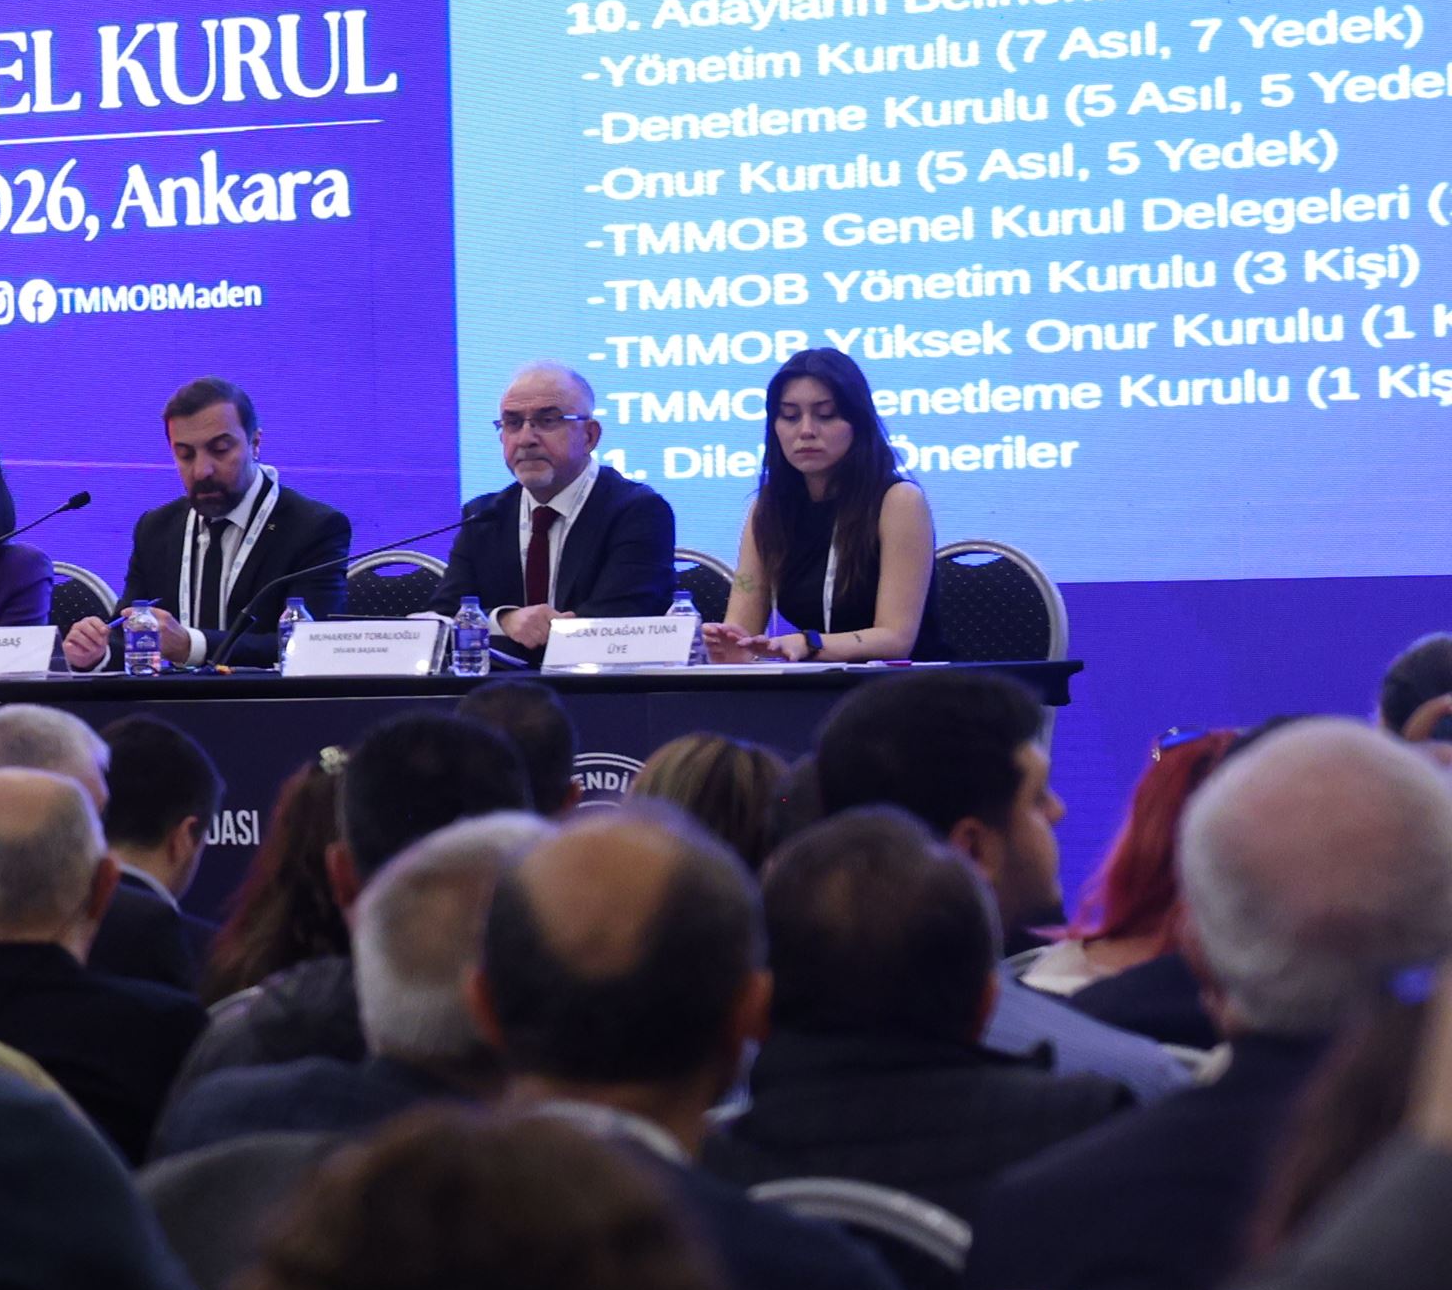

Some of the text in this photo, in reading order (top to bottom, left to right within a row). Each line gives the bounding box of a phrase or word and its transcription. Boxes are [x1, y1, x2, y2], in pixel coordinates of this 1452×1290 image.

[568, 1, 640, 34] 10.
[584, 6, 1422, 86] -Yönetim Kurulu (7 Asıl, 7 Yedek)
[99, 10, 397, 108] KURUL
[585, 105, 865, 143] -Denetleme
[886, 89, 1046, 127] Kurulu
[1067, 85, 1114, 125] (5
[1129, 77, 1240, 114] Asıl,
[1262, 75, 1292, 106] 5
[112, 150, 350, 229] Ankara
[587, 130, 1336, 199] -Onur Kurulu (5 Asıl, 5 Yedek)
[588, 217, 806, 254] -TMMOB
[825, 208, 972, 245] Genel
[993, 201, 1123, 237] Kurul
[1144, 186, 1408, 233] Delegeleri
[59, 282, 261, 314] TMMOBMaden
[589, 245, 1418, 310] -TMMOB Yönetim Kurulu (3 Kişi)
[590, 331, 806, 367] -TMMOB
[827, 322, 1010, 358] Yüksek
[1027, 321, 1154, 351] Onur
[1175, 309, 1342, 346] Kurulu
[1364, 306, 1413, 346] (1
[592, 389, 767, 423] -TMMO
[872, 380, 1100, 415] enetleme
[1122, 370, 1288, 406] Kurulu
[1309, 368, 1358, 408] (1
[892, 436, 1077, 471] Öneriler
[607, 643, 628, 654] ÜYE
[648, 624, 677, 635] TUNA
